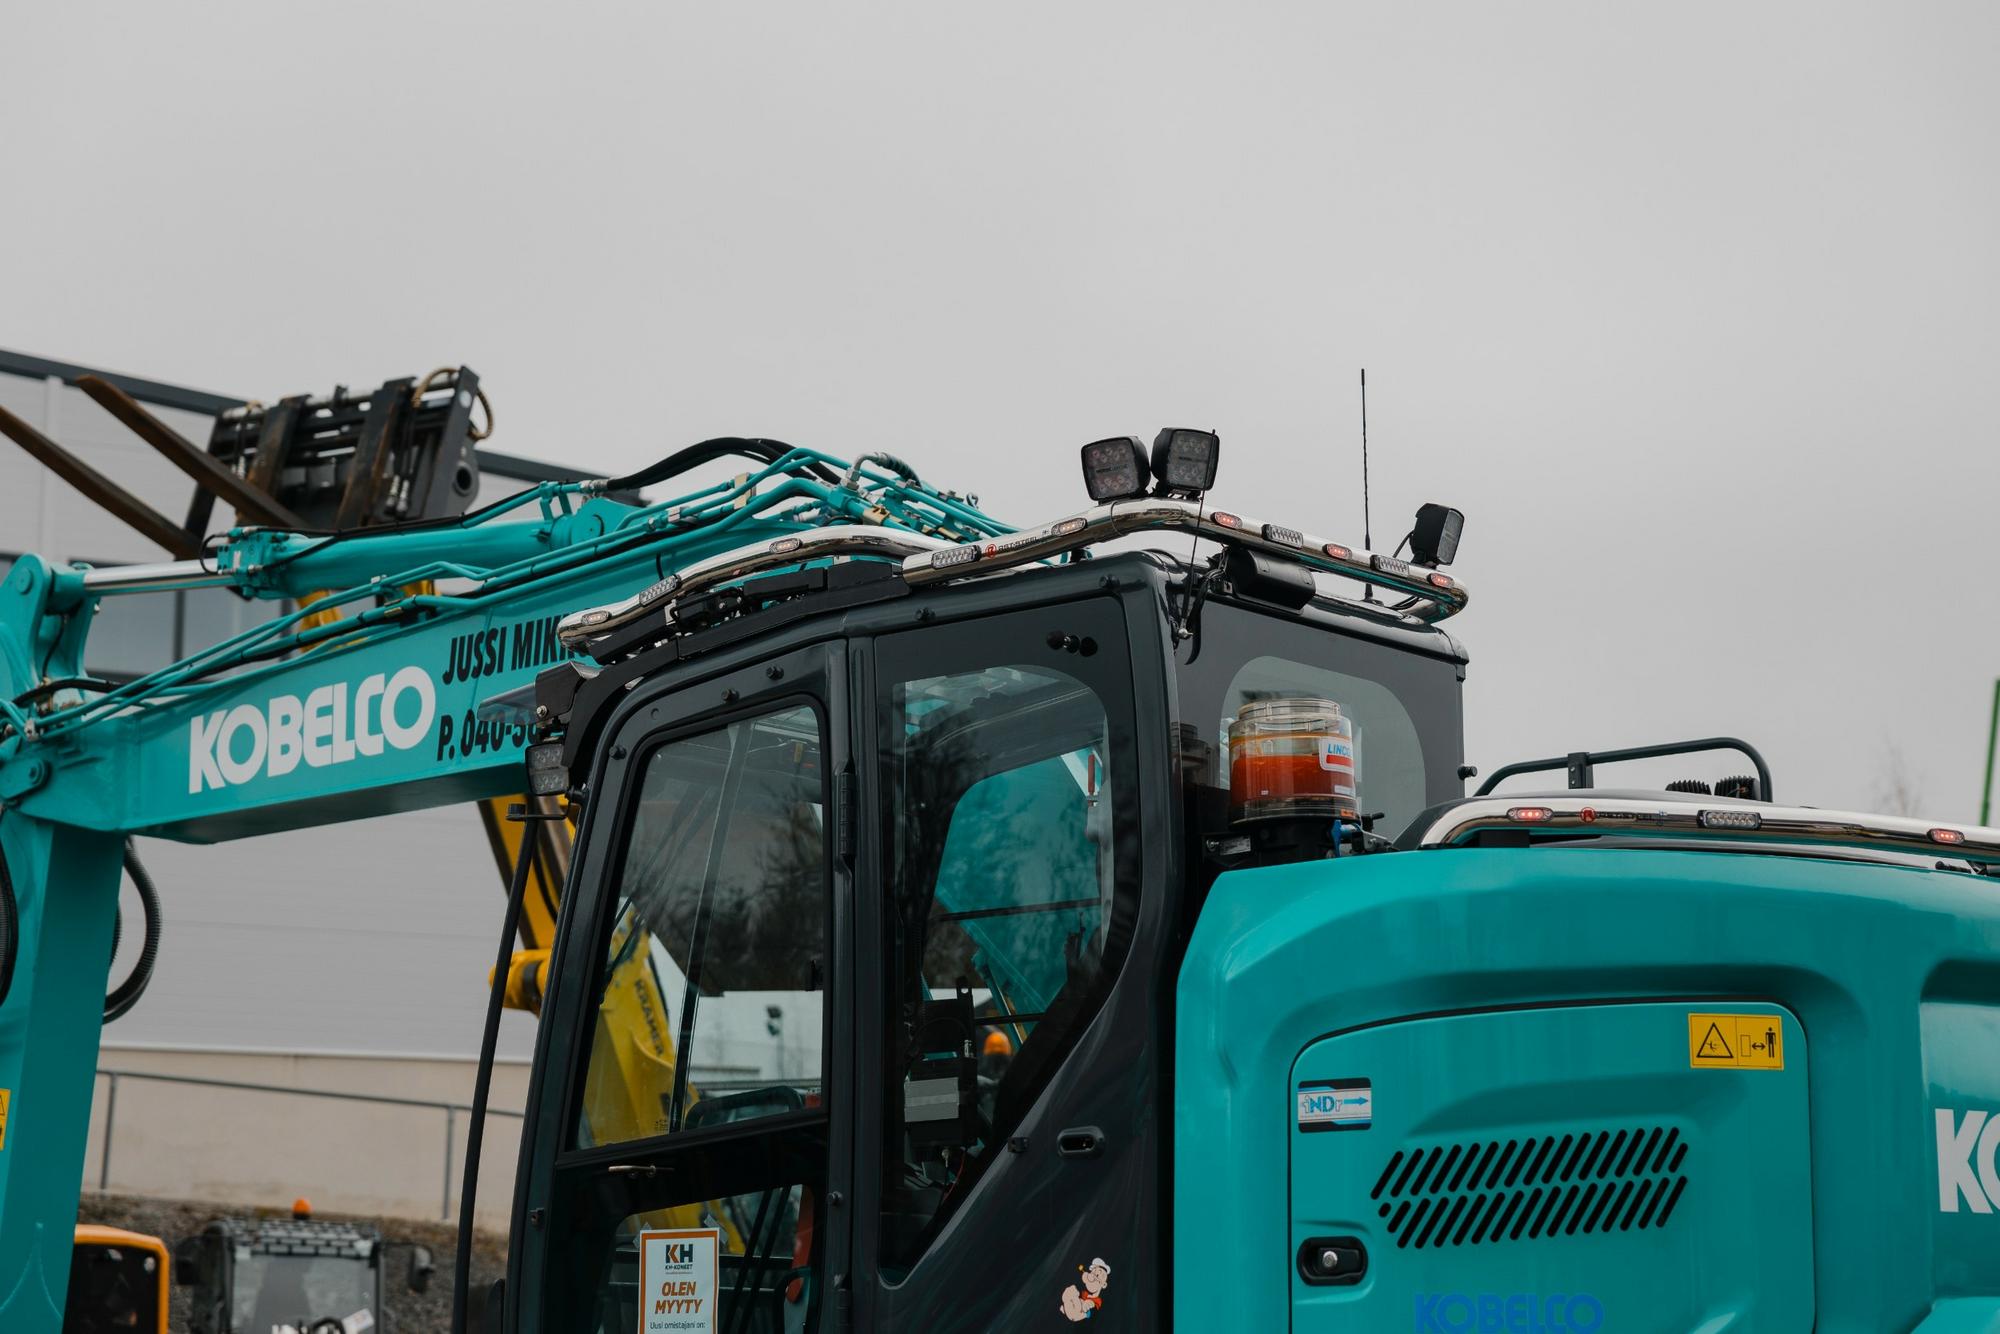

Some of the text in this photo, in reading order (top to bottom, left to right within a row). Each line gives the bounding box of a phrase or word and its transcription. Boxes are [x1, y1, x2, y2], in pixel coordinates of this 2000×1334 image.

[443, 626, 507, 685] JUSSI
[189, 666, 436, 794] KOBELCO
[437, 714, 455, 762] P.
[635, 979, 663, 1055] KRAMER
[665, 1243, 694, 1264] KH
[654, 1299, 704, 1315] MYYTY
[661, 1281, 697, 1297] OLEN
[649, 1320, 706, 1331] Uusi omistajani on:
[1415, 1294, 1605, 1334] KOBELCO
